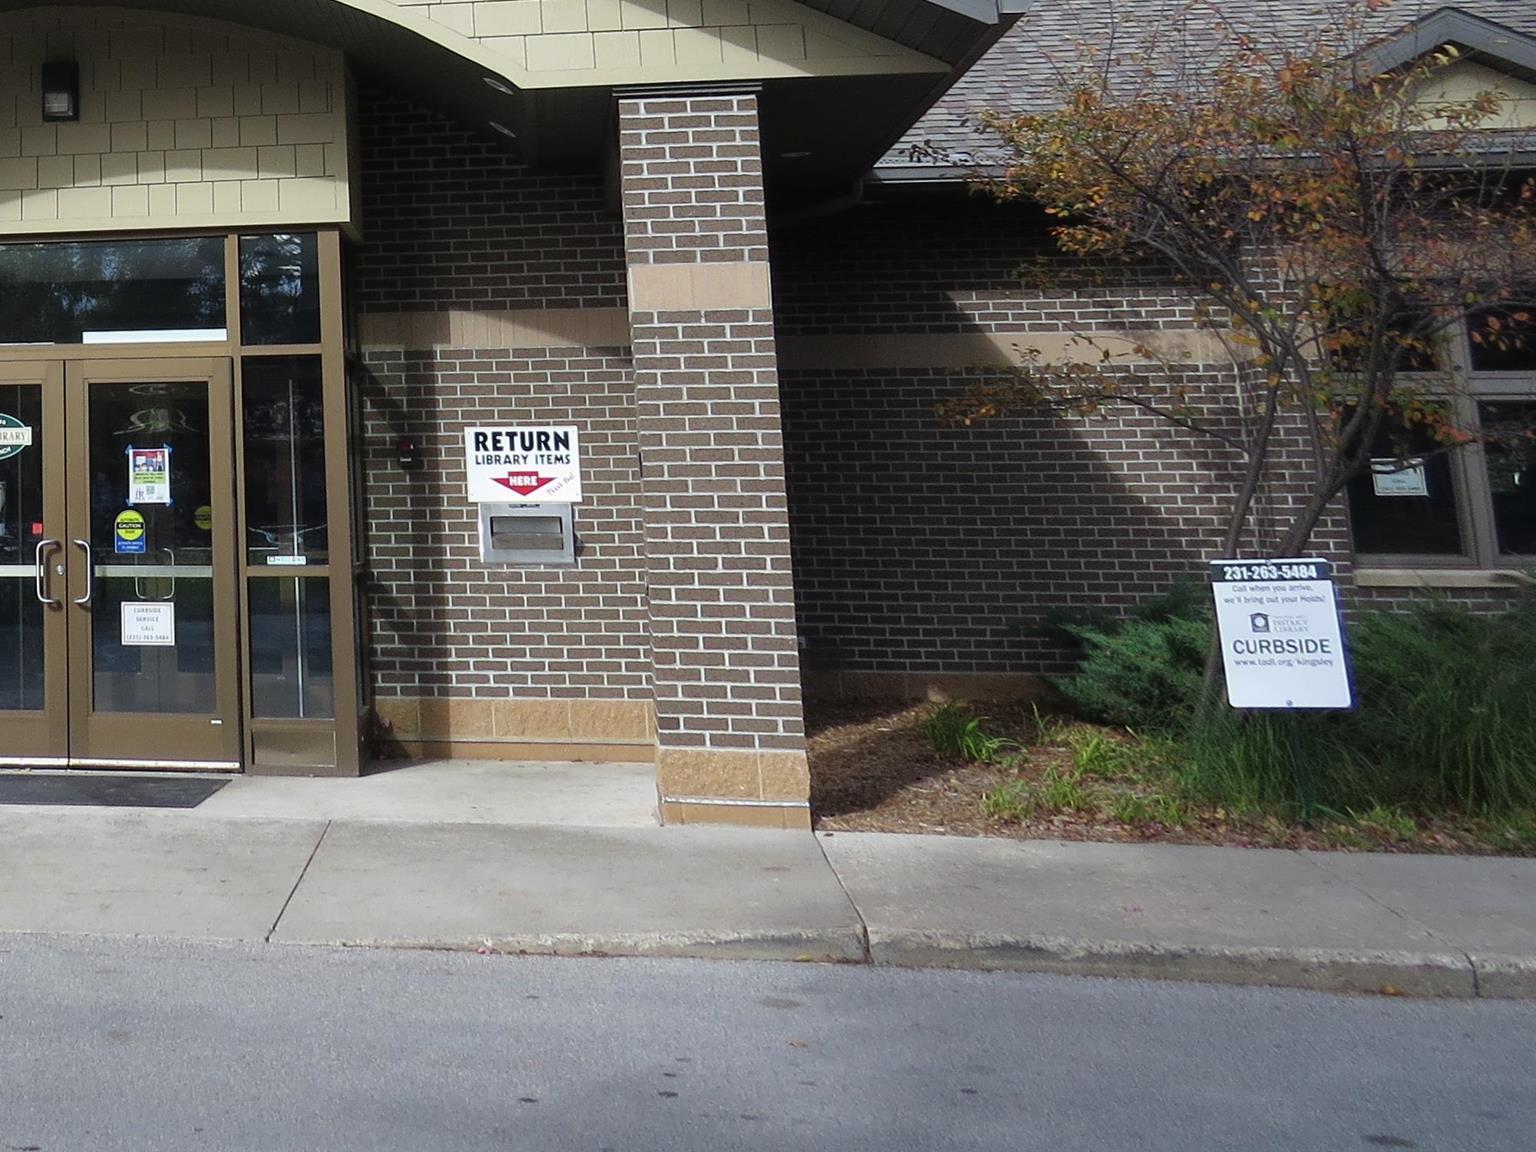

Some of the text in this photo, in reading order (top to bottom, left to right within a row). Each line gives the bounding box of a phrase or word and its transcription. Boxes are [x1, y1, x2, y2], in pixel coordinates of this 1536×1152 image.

[474, 431, 570, 452] RETURN
[475, 454, 571, 465] LIBRARY ITEMS
[508, 475, 539, 487] HERE
[1223, 565, 1317, 580] 231-263-5484
[1243, 596, 1264, 604] bring
[1281, 596, 1298, 604] your
[1232, 638, 1332, 655] CURBSIDE
